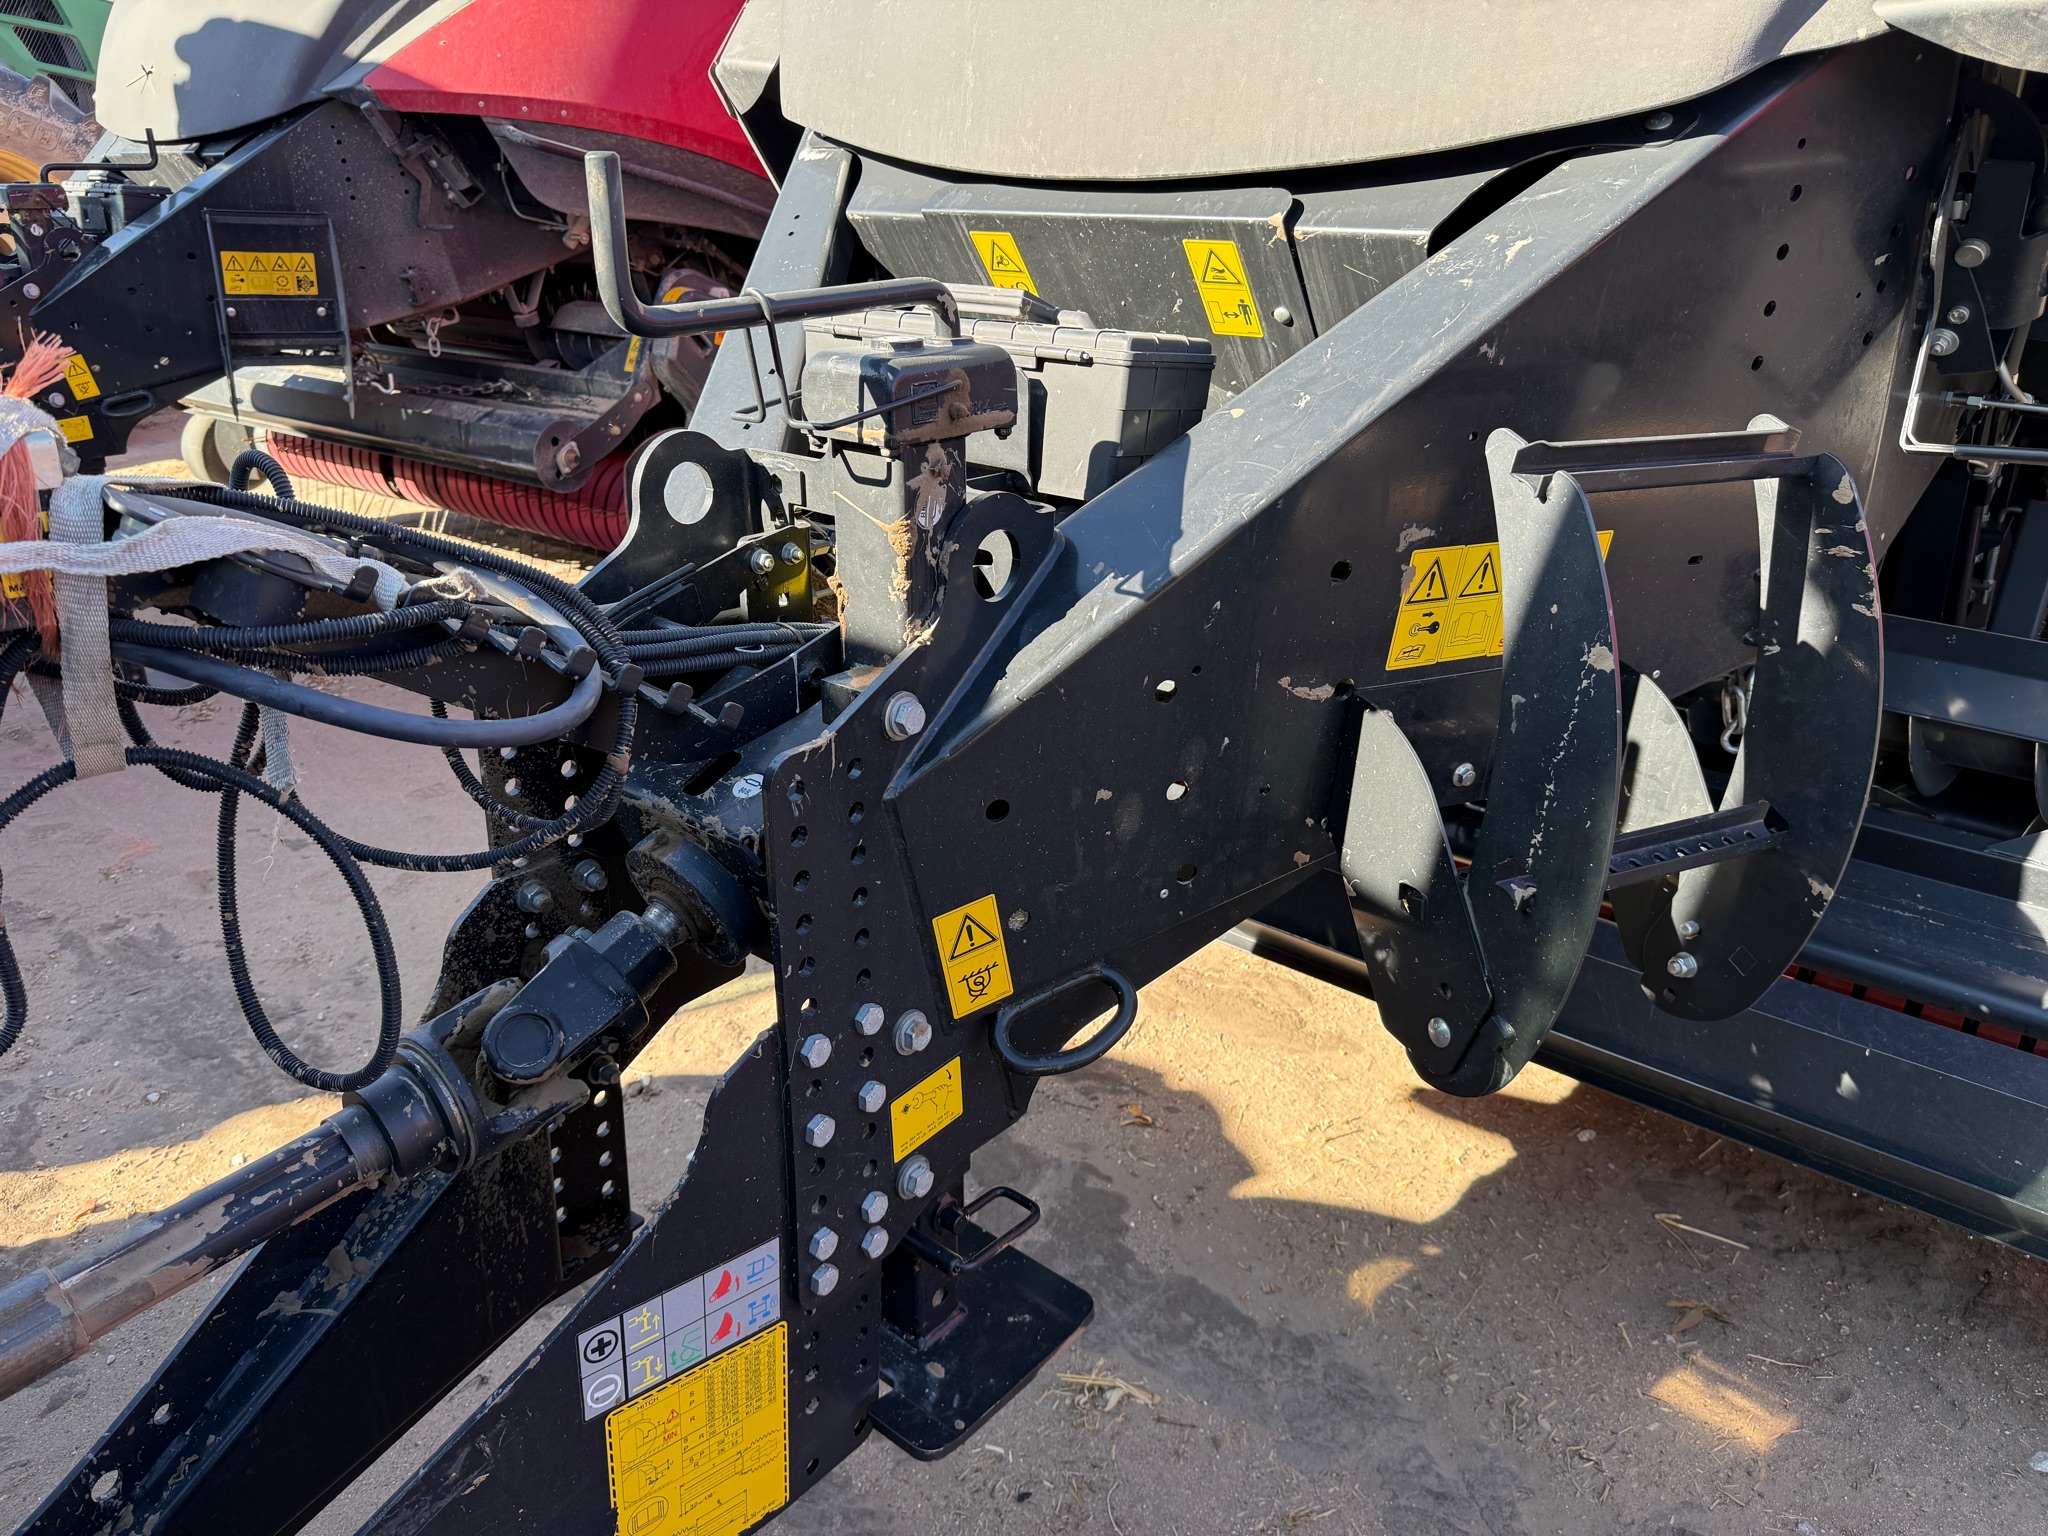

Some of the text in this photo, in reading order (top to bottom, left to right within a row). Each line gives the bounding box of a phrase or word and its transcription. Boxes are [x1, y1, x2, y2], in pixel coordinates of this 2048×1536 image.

[680, 1374, 703, 1387] MACHINE
[637, 1397, 659, 1410] HITCH
[689, 1398, 694, 1406] P
[690, 1414, 695, 1423] R
[698, 1431, 704, 1440] R
[724, 1429, 728, 1437] U
[689, 1455, 694, 1463] S
[693, 1460, 698, 1469] R
